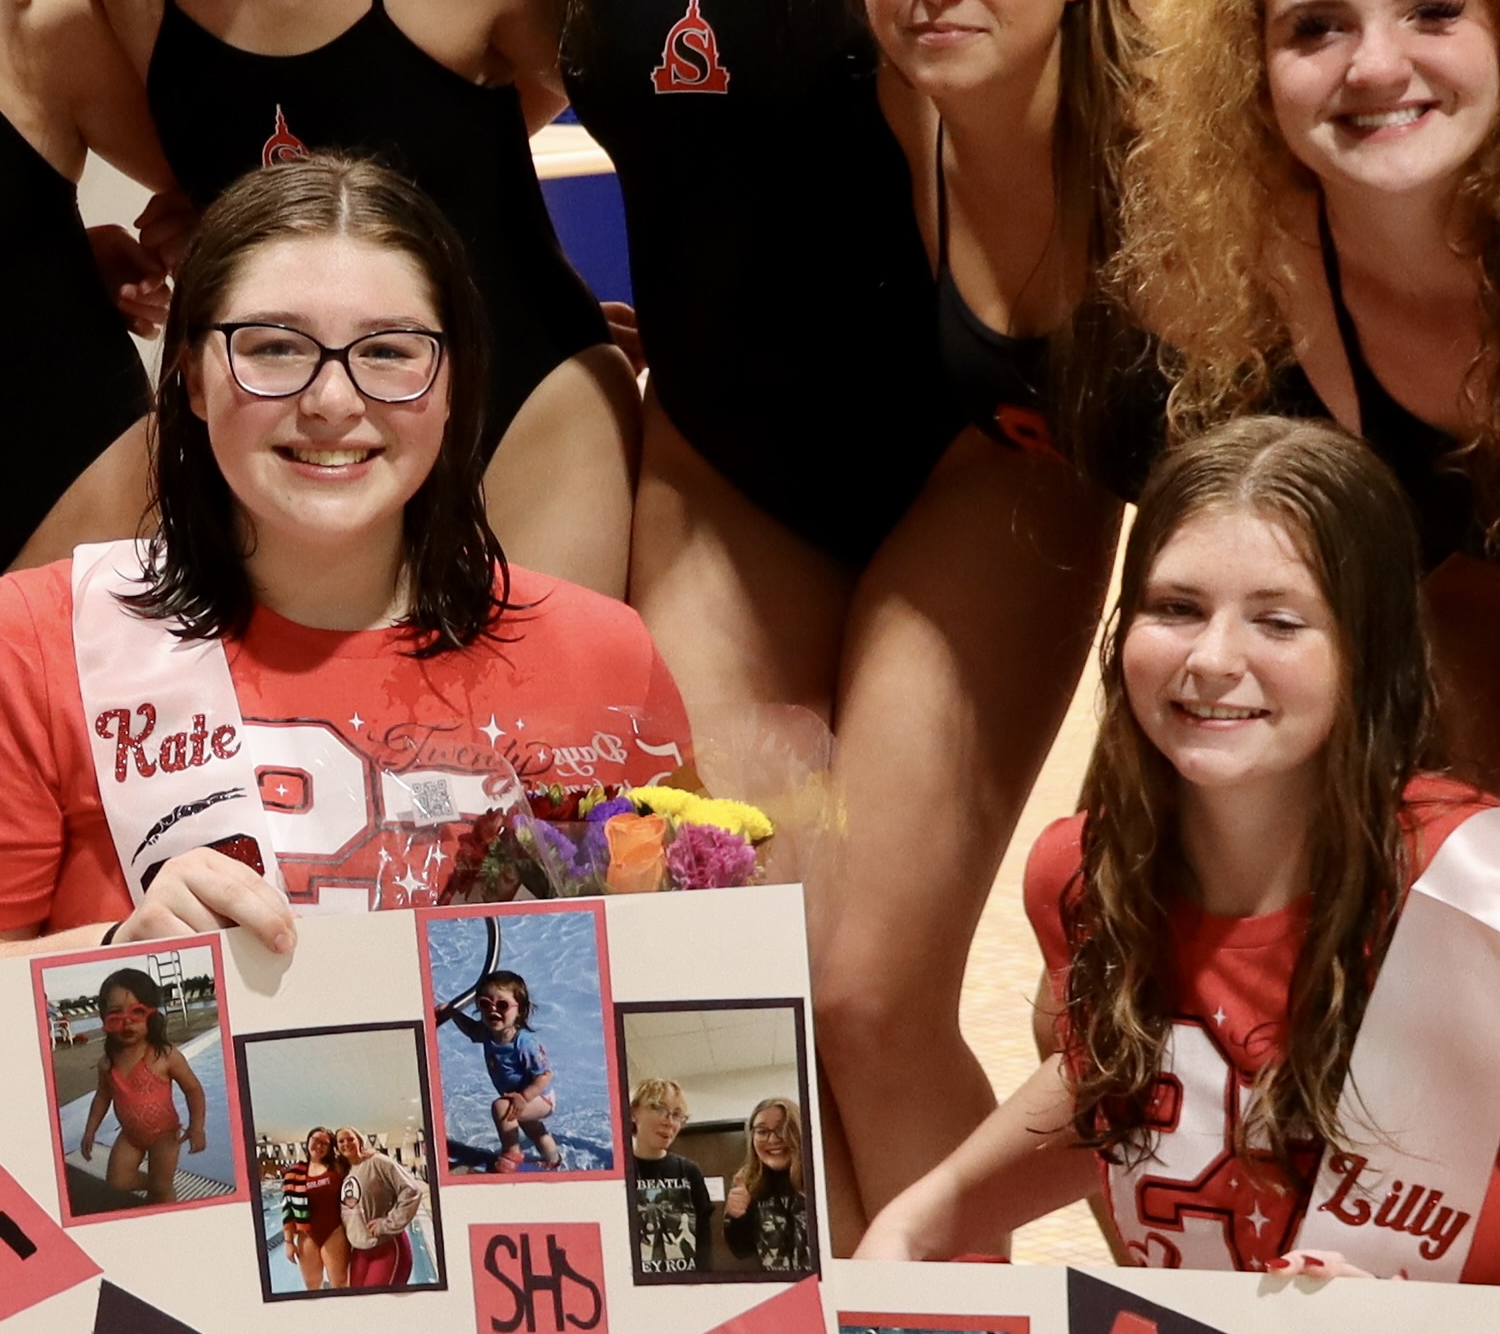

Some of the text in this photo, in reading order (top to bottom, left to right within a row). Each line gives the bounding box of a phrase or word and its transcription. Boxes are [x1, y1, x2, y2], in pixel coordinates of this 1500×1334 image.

[671, 26, 711, 85] S
[94, 701, 242, 783] Kate
[1318, 1151, 1471, 1261] Lilly
[483, 1232, 602, 1334] SHS
